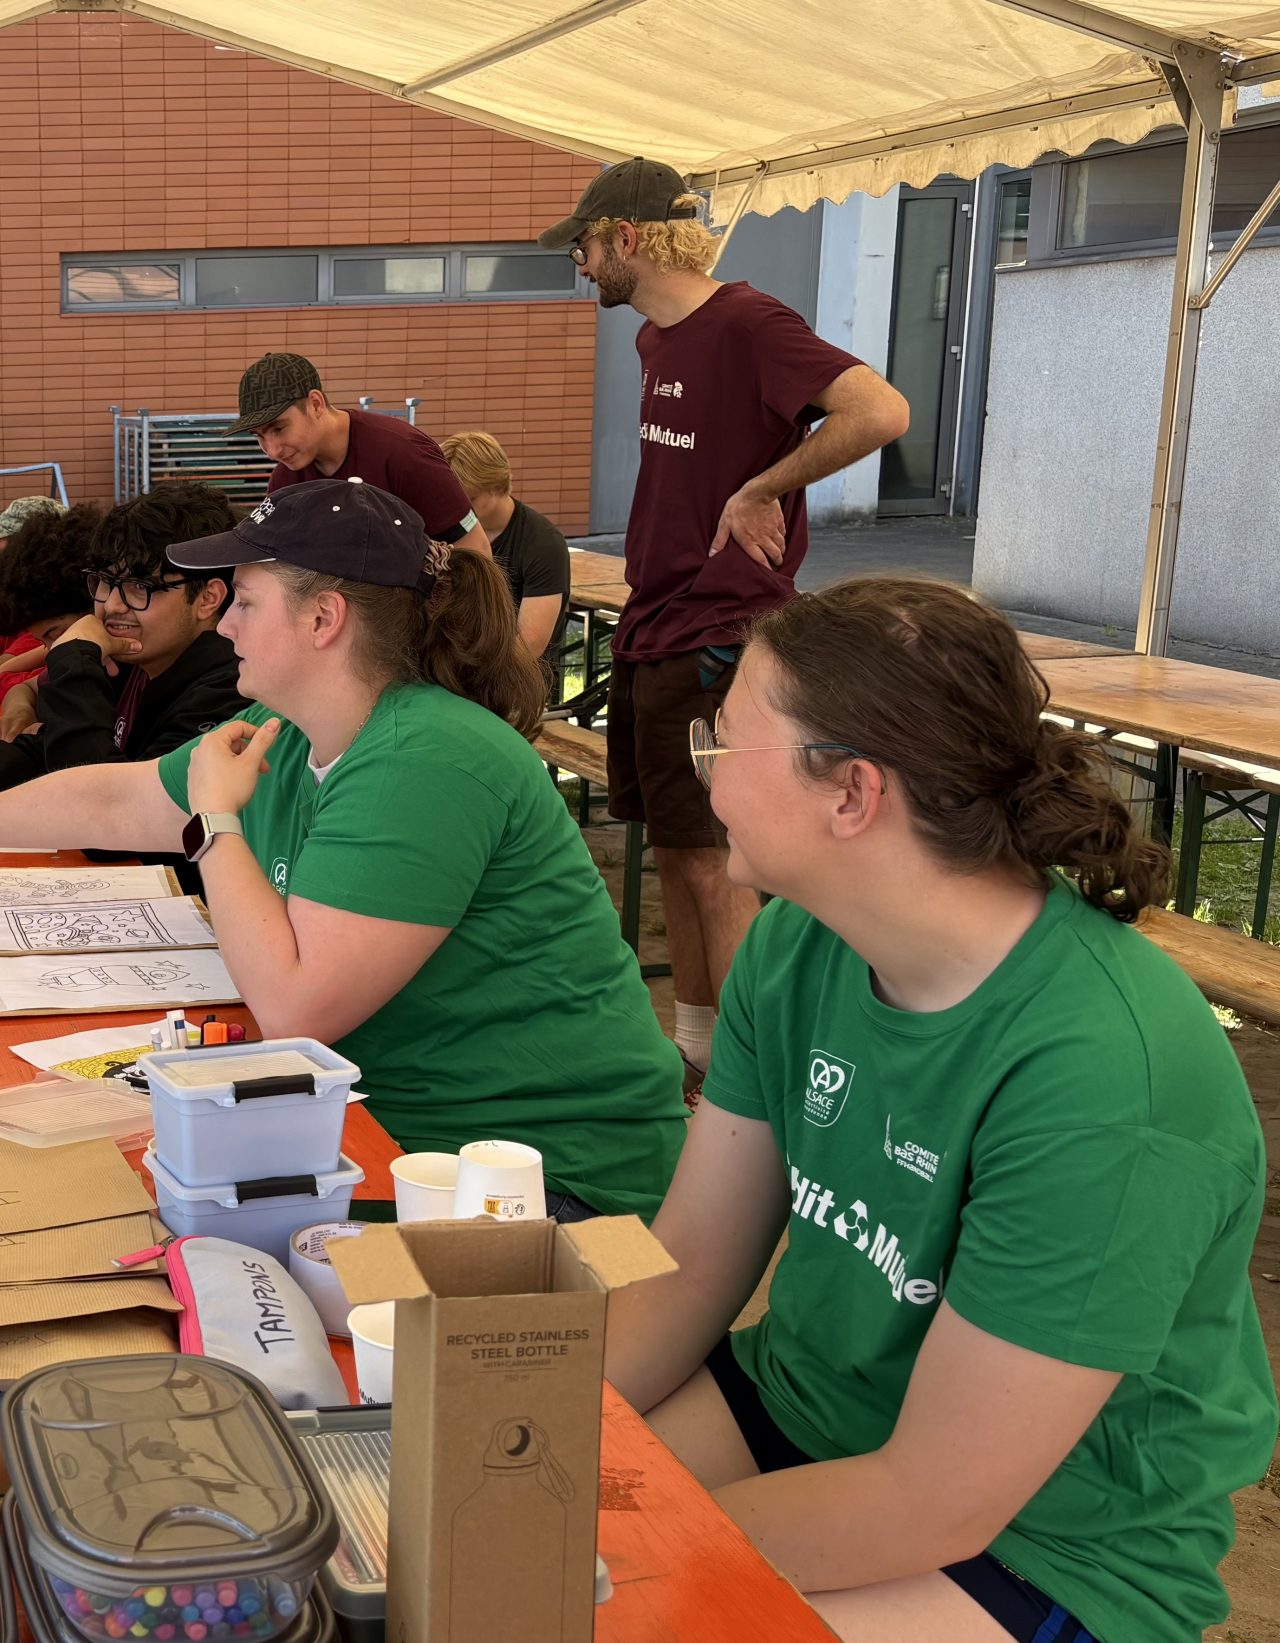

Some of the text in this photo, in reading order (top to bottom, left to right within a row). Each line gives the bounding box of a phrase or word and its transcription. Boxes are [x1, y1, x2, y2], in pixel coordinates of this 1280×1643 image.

[649, 424, 696, 450] Mutuel
[915, 1155, 938, 1175] RHIN
[242, 1260, 296, 1354] TAMPONS
[446, 1329, 590, 1346] RECYCLED STAINLESS
[470, 1344, 568, 1360] STEEL BOTTLE
